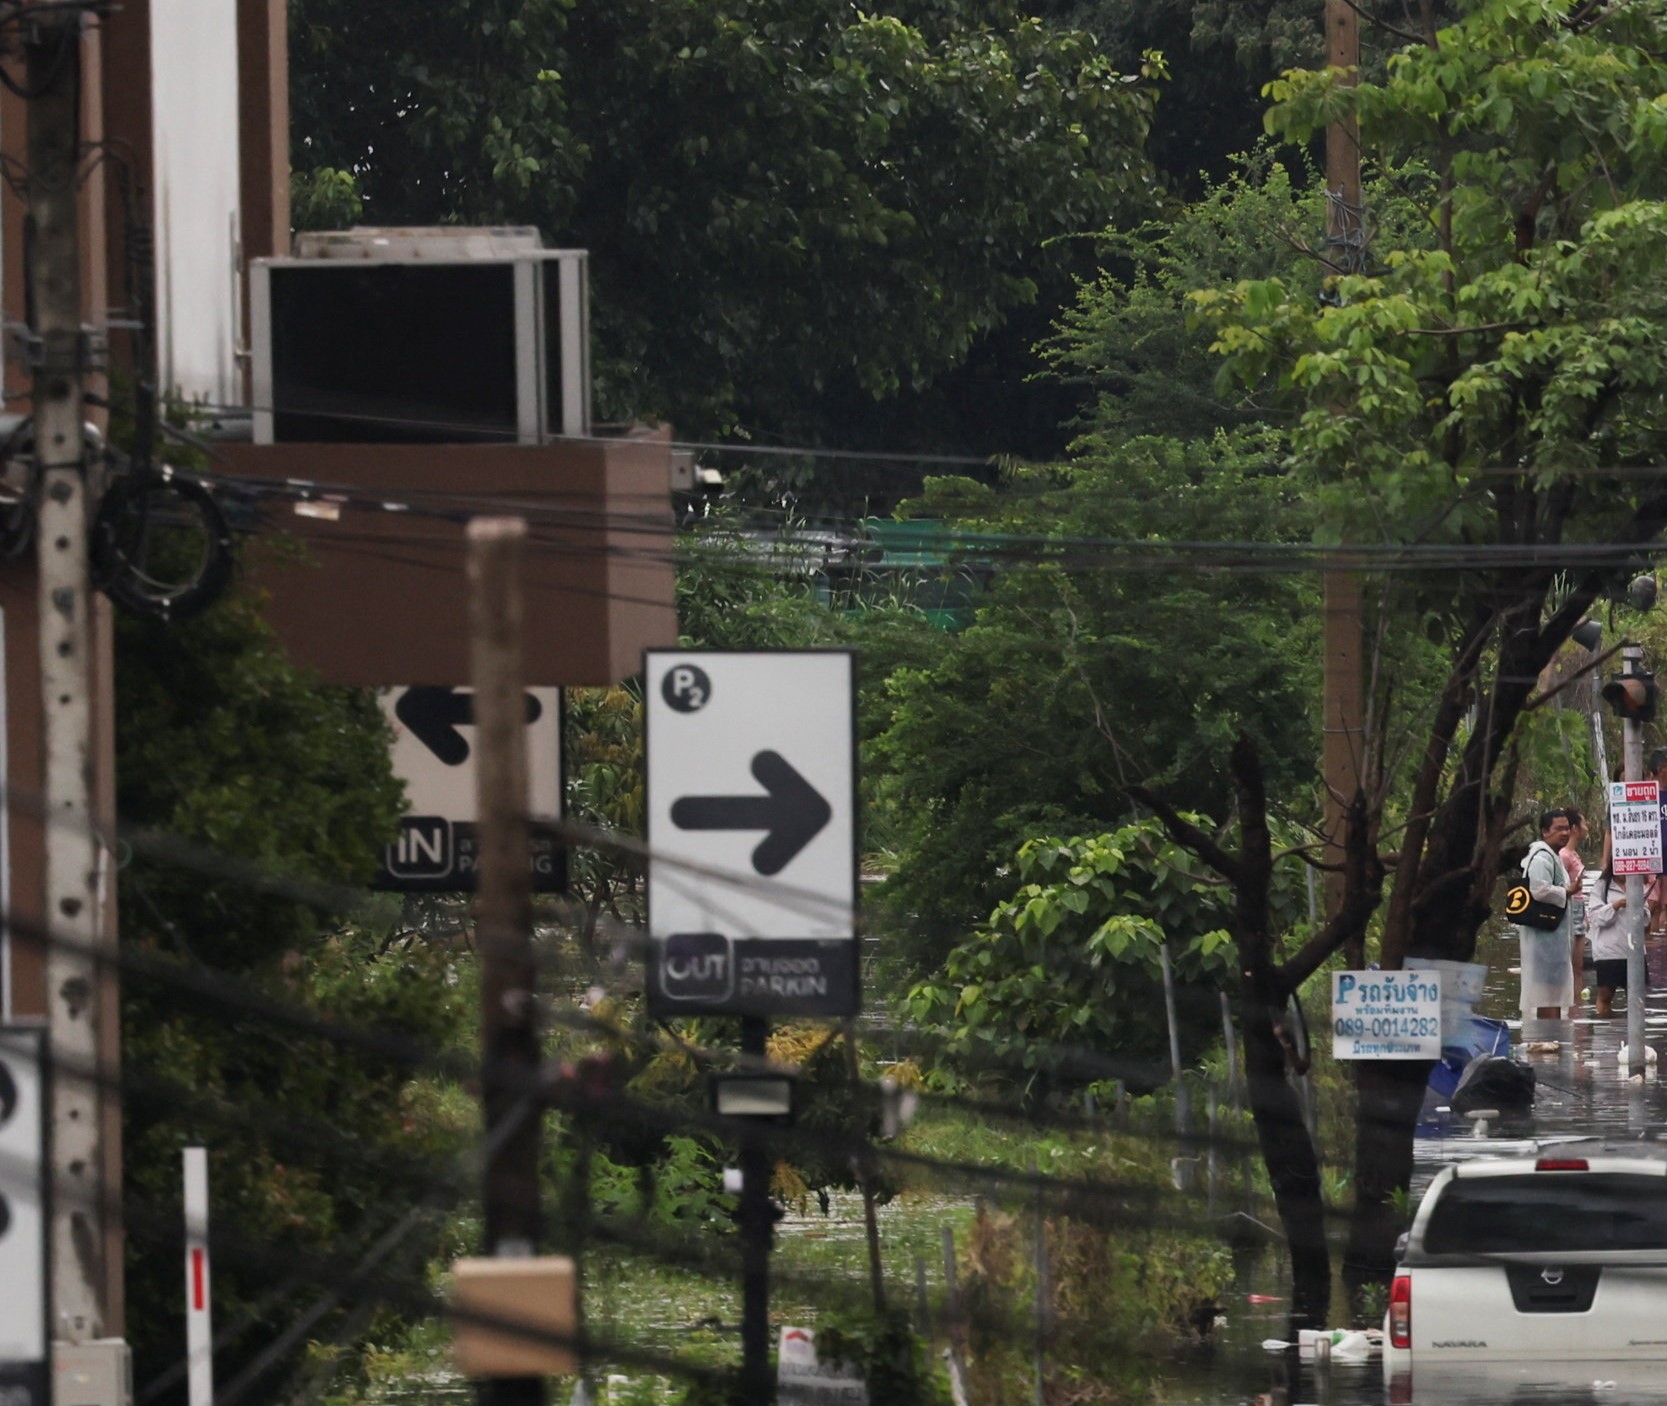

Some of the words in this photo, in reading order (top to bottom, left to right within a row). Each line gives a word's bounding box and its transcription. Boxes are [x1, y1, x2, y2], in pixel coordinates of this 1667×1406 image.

[668, 961, 726, 981] OUT
[1358, 974, 1439, 1003] รถรับจ้าง
[1335, 1017, 1439, 1038] 089-0014282
